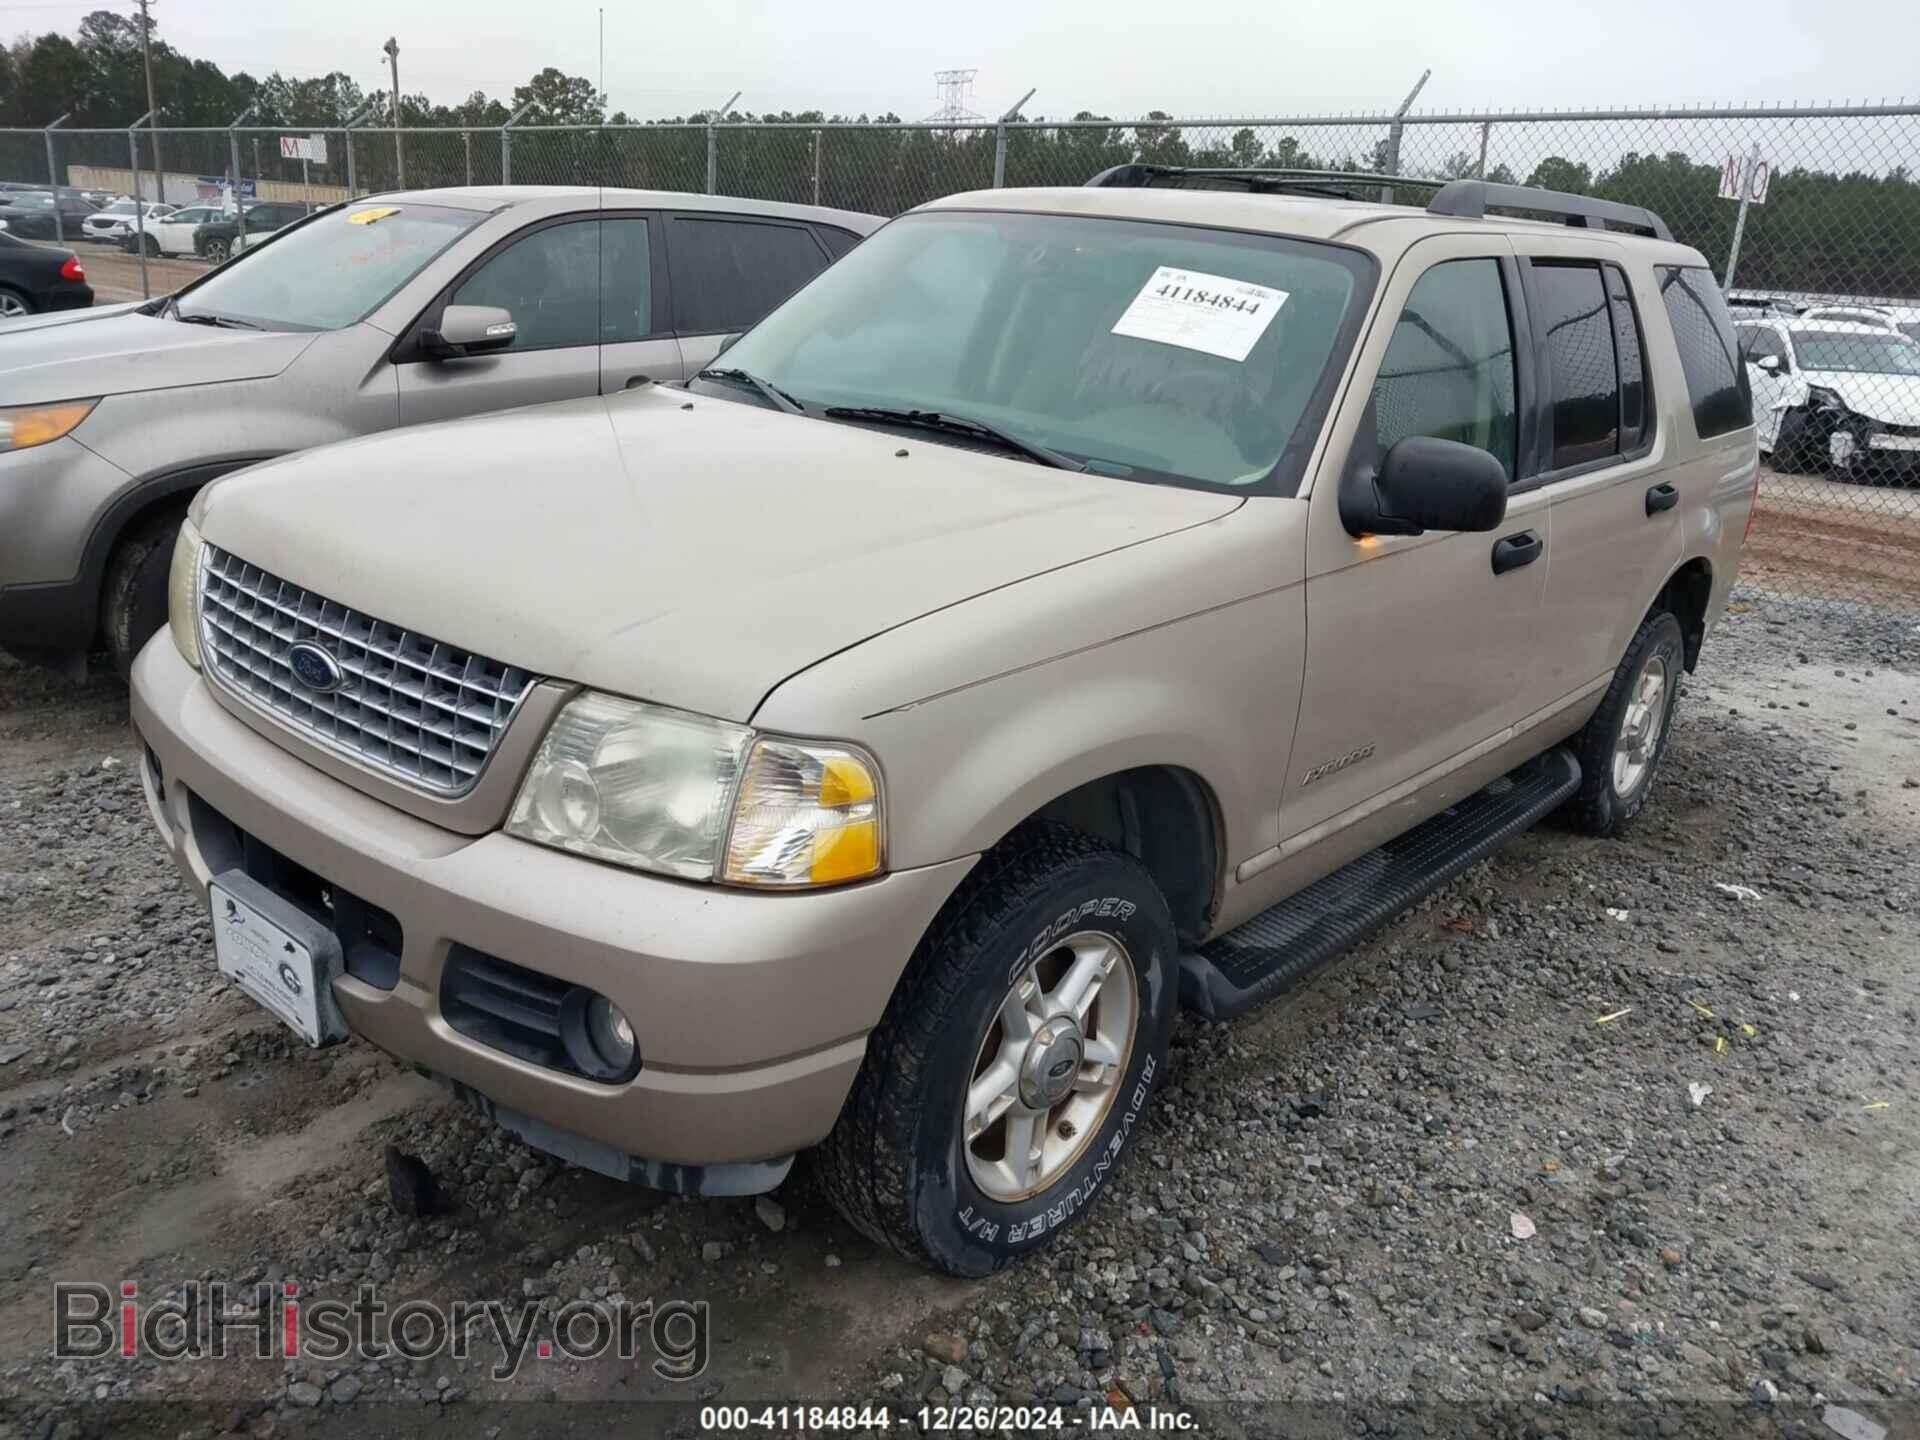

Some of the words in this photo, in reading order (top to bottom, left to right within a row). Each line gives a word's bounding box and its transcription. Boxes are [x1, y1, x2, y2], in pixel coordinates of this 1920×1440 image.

[1155, 283, 1261, 315] 41184844
[1008, 897, 1137, 985] COOPER
[1007, 1052, 1157, 1243] ADVENTURER
[958, 1205, 1000, 1242] H/T
